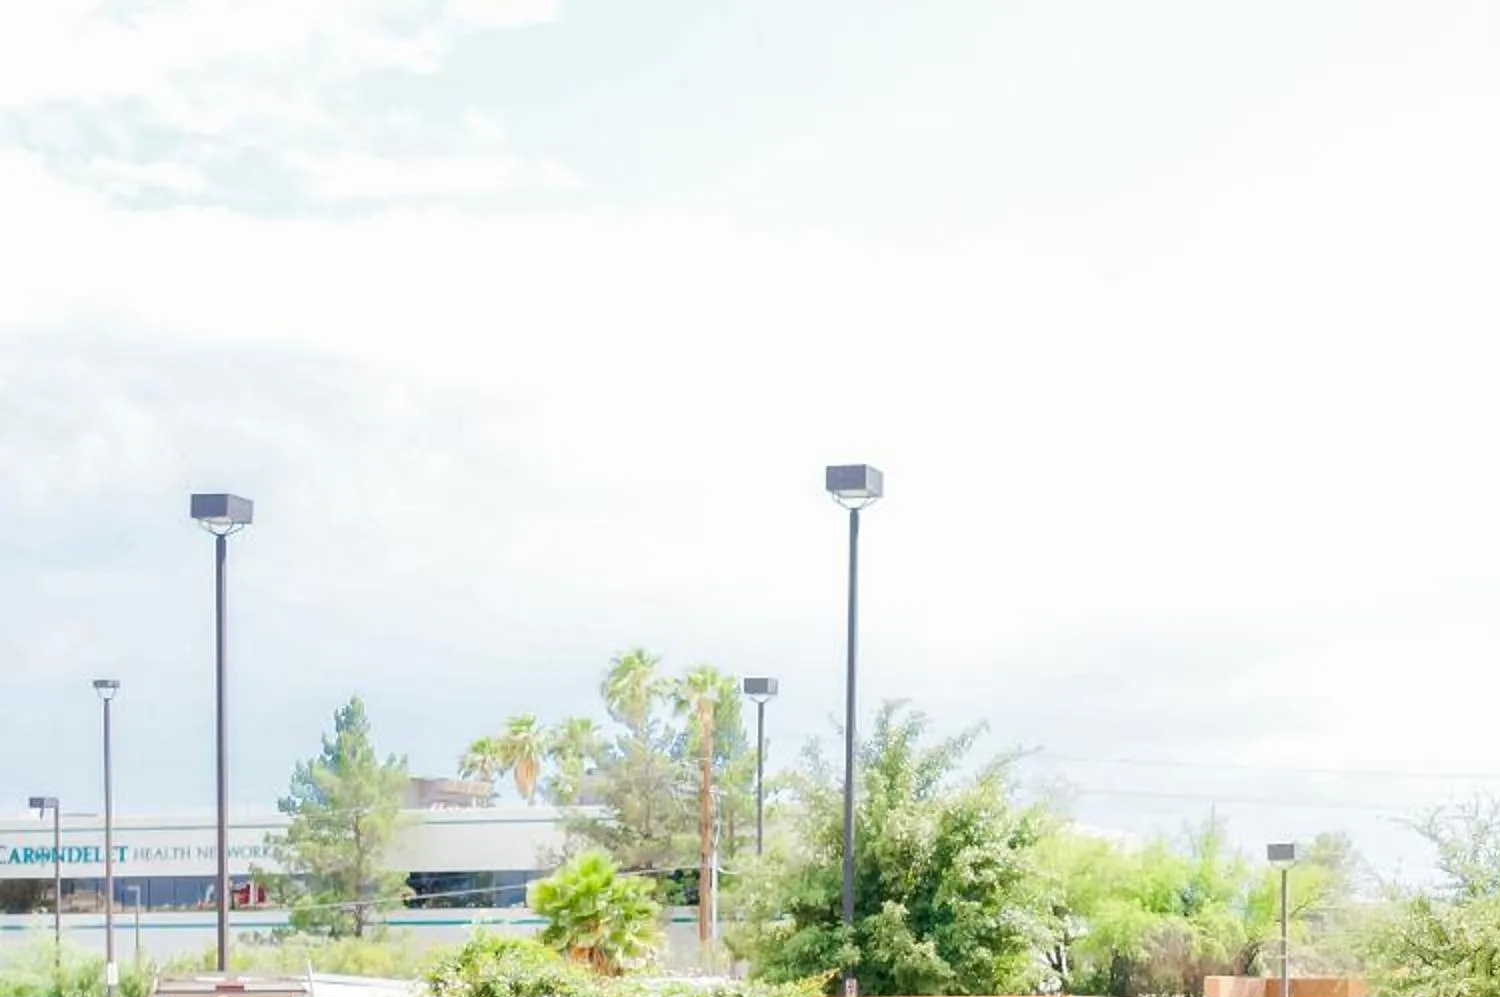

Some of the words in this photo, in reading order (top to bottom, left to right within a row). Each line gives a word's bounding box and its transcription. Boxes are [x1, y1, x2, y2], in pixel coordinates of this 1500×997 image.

[0, 845, 129, 865] ARONDELT
[133, 846, 191, 861] HEALTH
[198, 845, 276, 860] NEWORK
